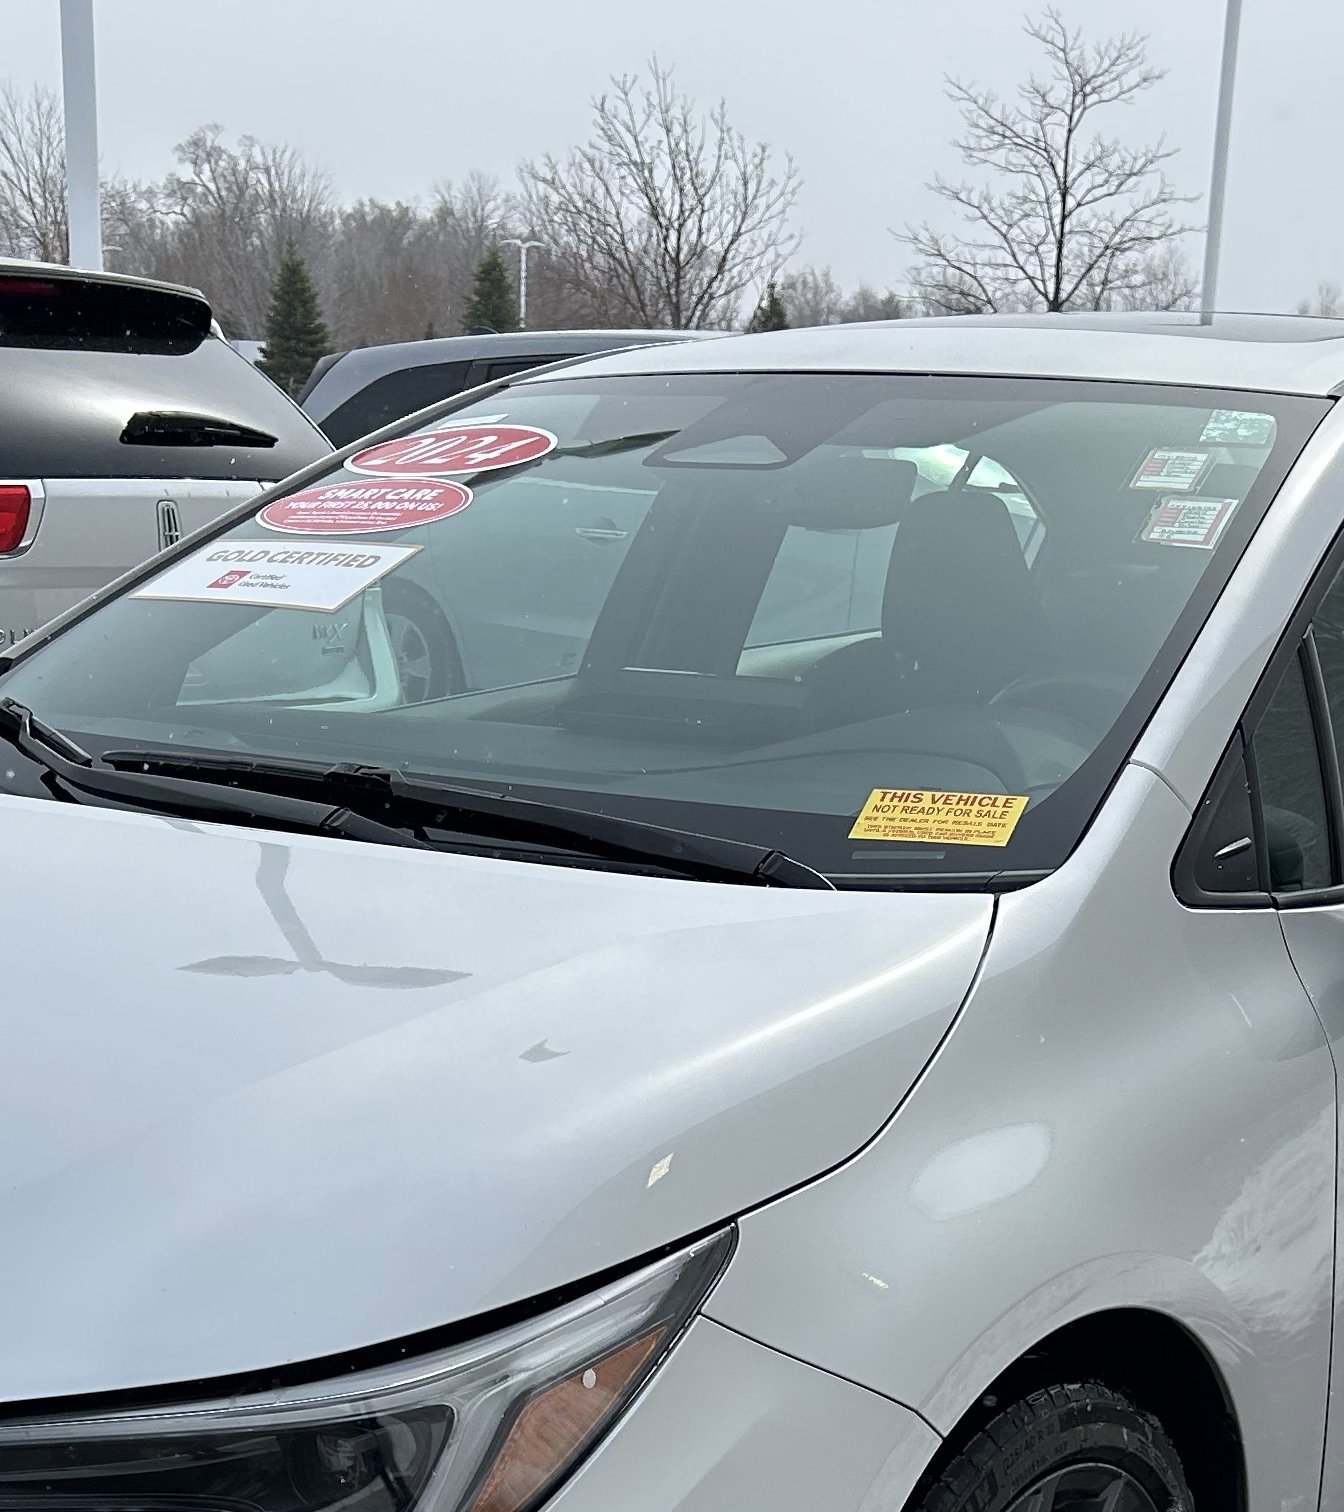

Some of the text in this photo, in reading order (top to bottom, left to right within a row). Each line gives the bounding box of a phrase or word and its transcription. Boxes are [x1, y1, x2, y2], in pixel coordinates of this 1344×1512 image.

[359, 435, 542, 466] 2024
[318, 488, 445, 500] SMART CARE
[285, 501, 322, 509] YOUR
[317, 501, 357, 509] FIRST
[395, 502, 419, 510] ON
[206, 550, 381, 569] GOLD CERTIFIED
[248, 573, 286, 581] Certified
[258, 582, 291, 590] Vehicles
[879, 791, 1018, 809] THIS VEHICLE
[871, 804, 1009, 820] NOT READY FOR SALE
